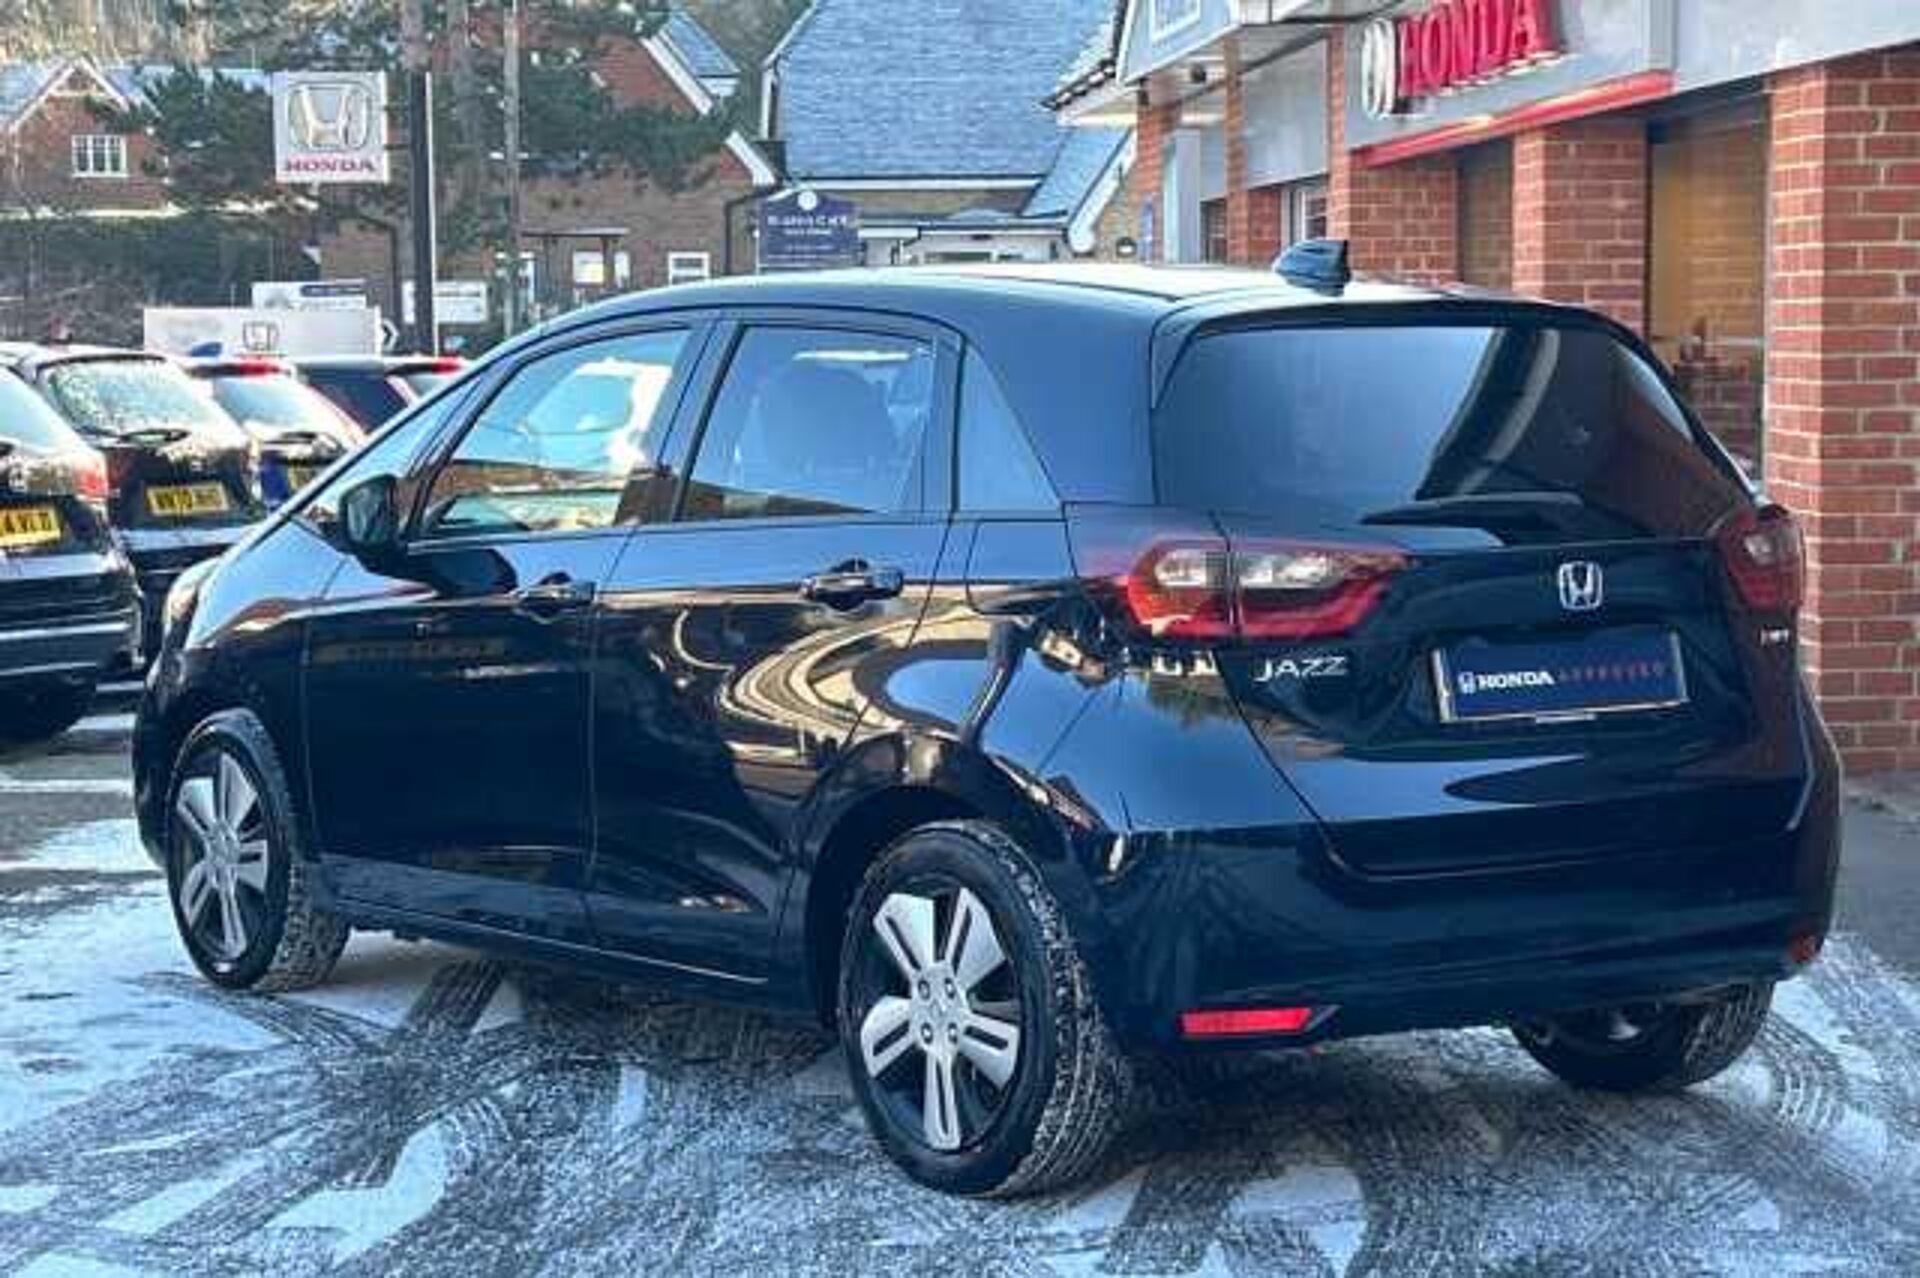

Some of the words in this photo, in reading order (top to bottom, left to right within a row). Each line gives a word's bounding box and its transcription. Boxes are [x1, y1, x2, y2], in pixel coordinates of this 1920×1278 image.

[1399, 0, 1548, 97] HONDA
[285, 159, 376, 172] HONDA
[1253, 656, 1346, 682] JAZZ
[1476, 670, 1555, 690] HONDA
